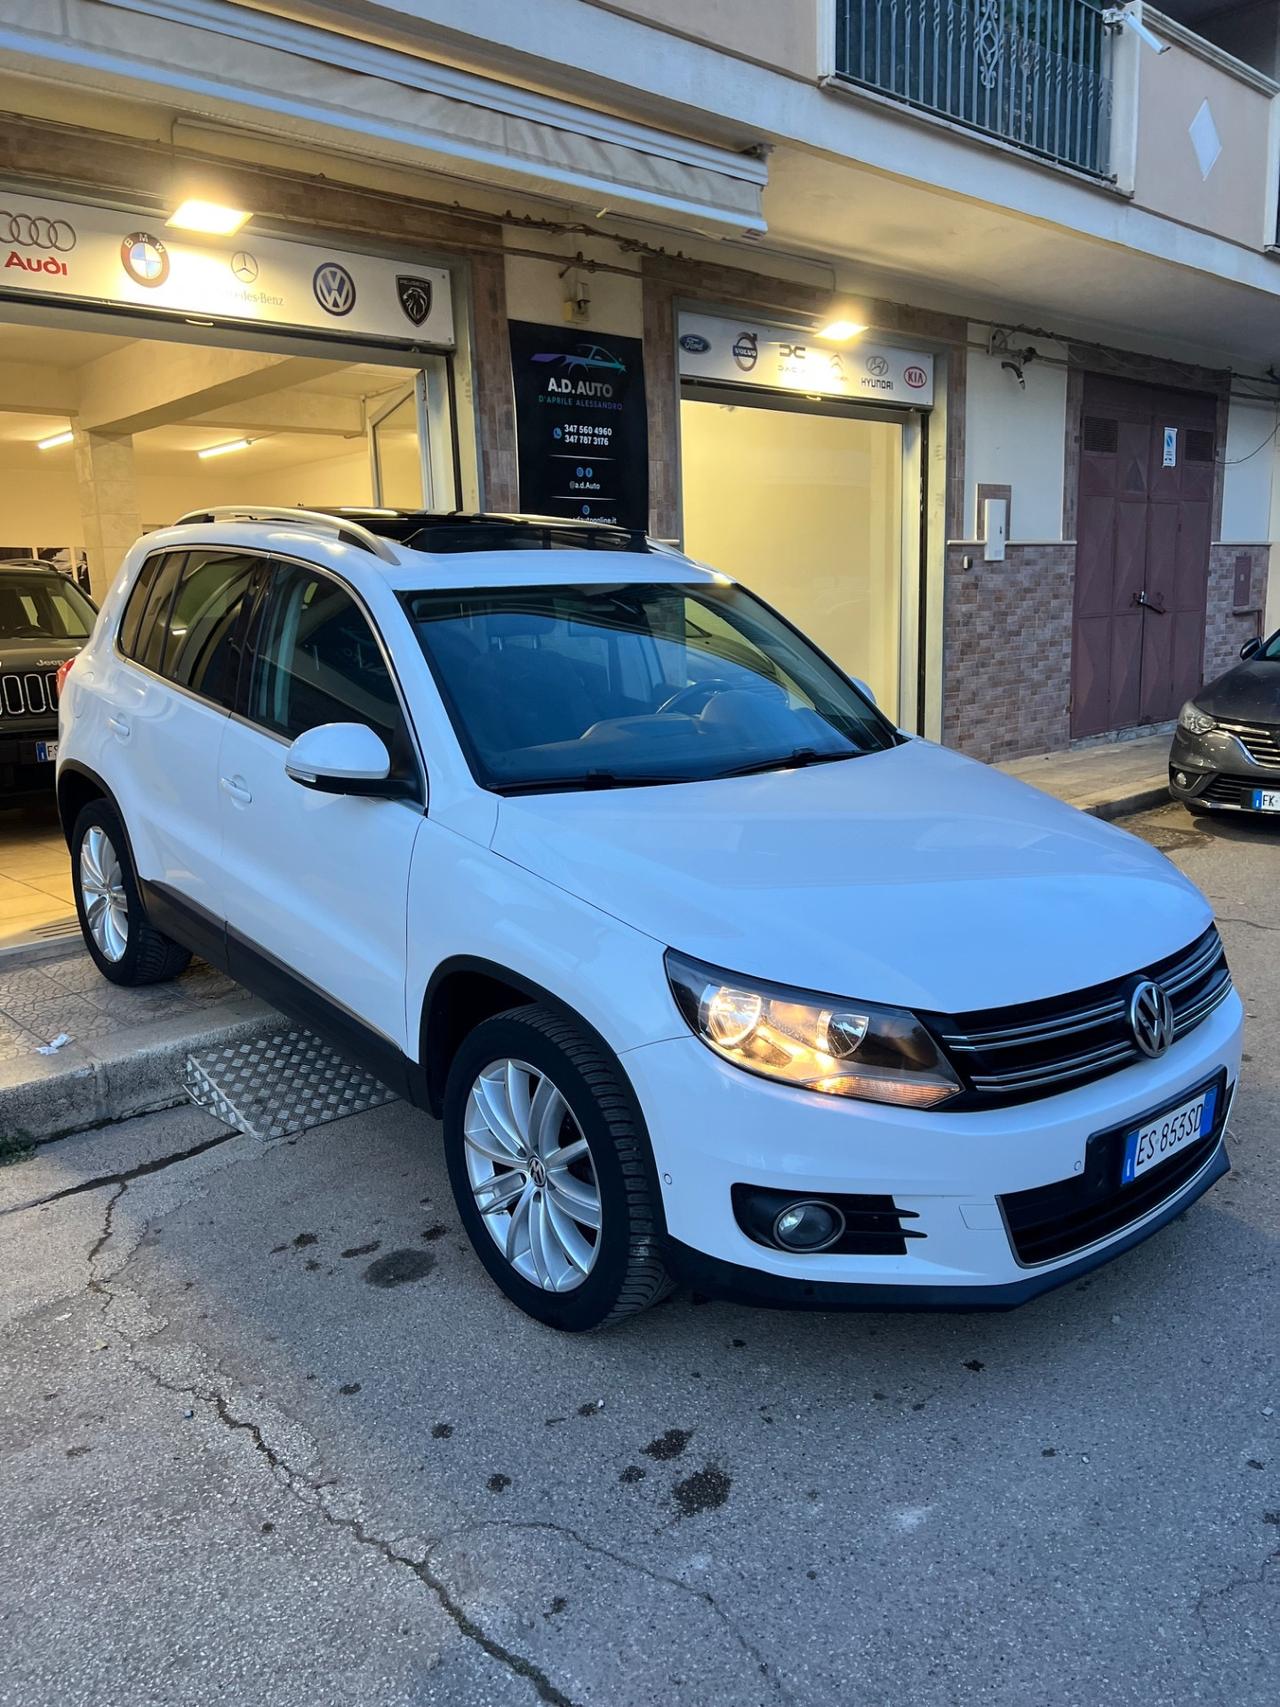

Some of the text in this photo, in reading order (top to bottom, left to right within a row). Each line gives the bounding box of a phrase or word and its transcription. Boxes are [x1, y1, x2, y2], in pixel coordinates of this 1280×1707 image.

[124, 233, 166, 254] BMW
[5, 251, 68, 276] Audi
[684, 336, 705, 351] Ford
[734, 347, 757, 357] VOLVO
[861, 377, 894, 390] HYUNDAI
[907, 371, 924, 384] KIA
[575, 400, 623, 411] ALESSANDRO
[564, 424, 613, 436] 347 560 4960
[564, 435, 578, 443] 347
[1262, 794, 1275, 806] FK
[1136, 1129, 1157, 1167] ES
[1159, 1103, 1204, 1153] 853SD
